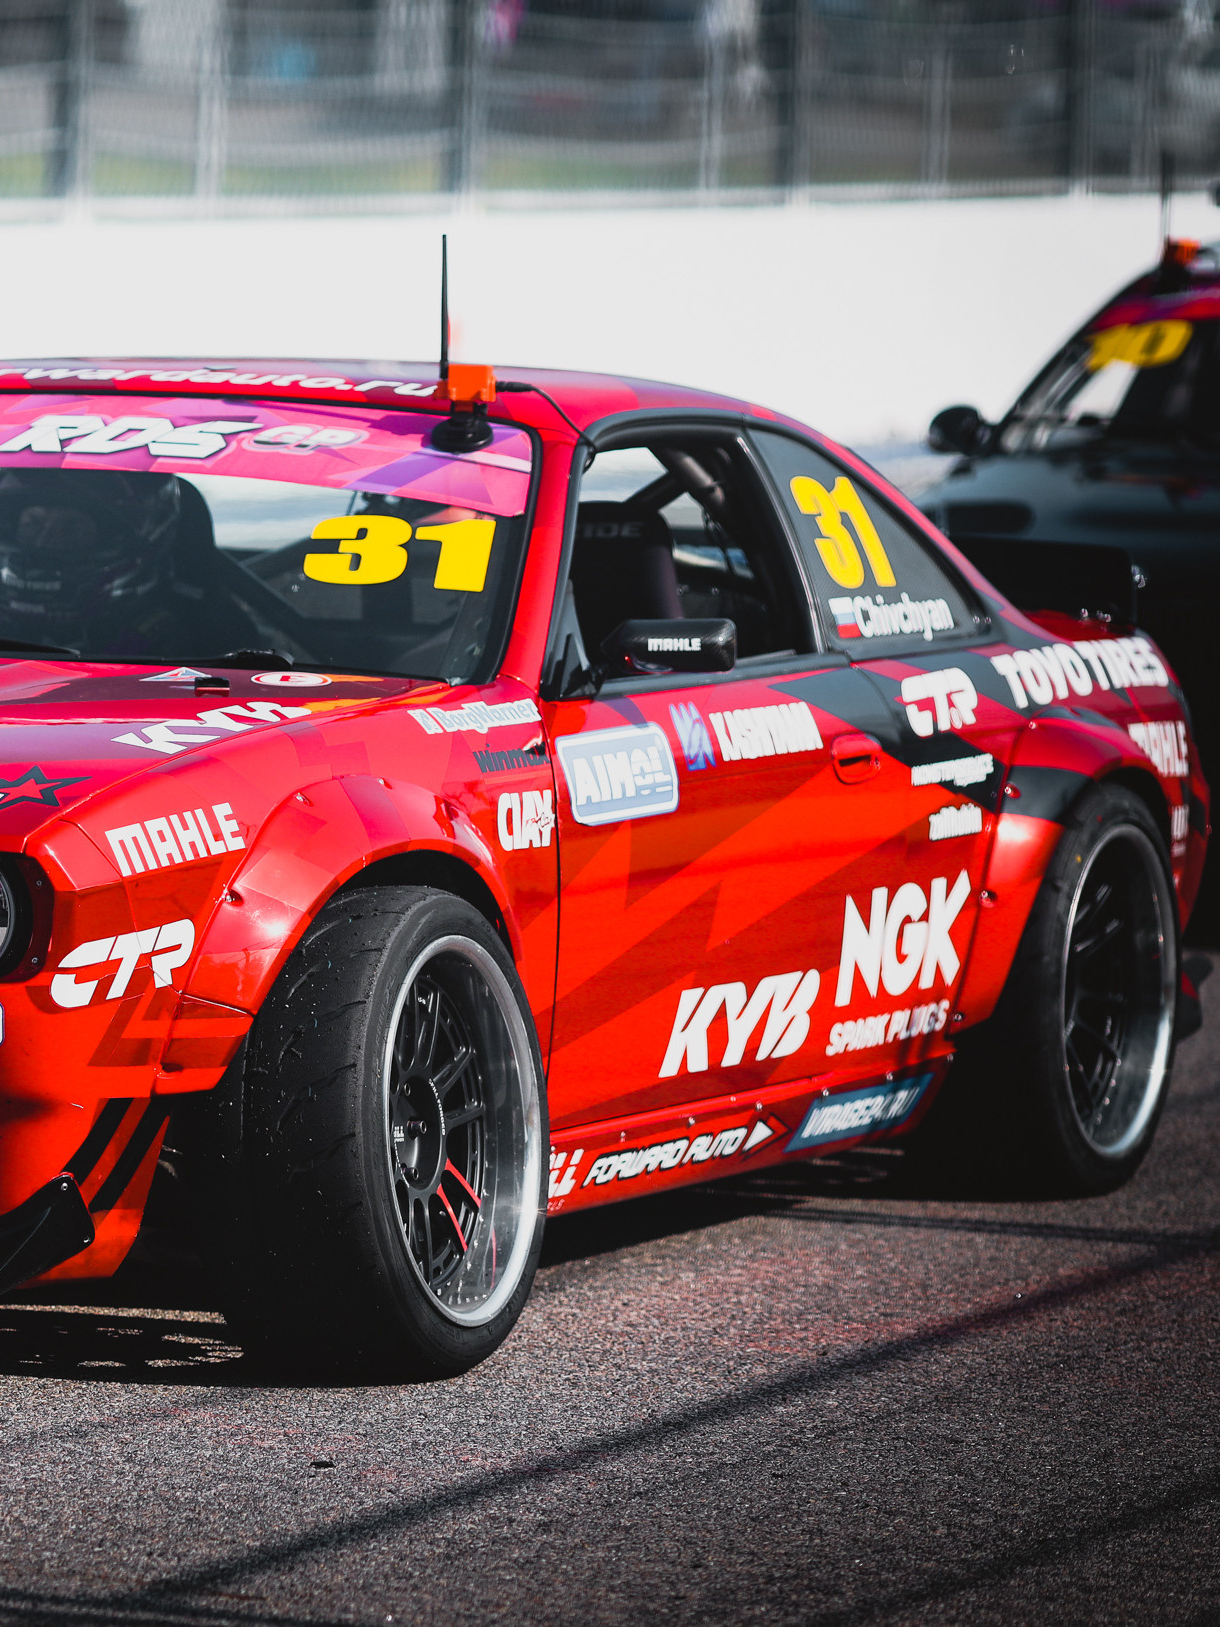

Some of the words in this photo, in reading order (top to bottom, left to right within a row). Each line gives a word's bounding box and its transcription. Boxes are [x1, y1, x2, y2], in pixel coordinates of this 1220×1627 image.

[303, 514, 498, 593] 31
[789, 475, 897, 589] 31
[647, 637, 702, 652] MAHLE
[990, 642, 1093, 709] TOYO
[1071, 636, 1170, 691] TIRES
[110, 701, 312, 754] KYB
[432, 700, 538, 731] BorgWarner
[104, 802, 246, 877] MAHLE
[835, 868, 972, 1007] NGK
[657, 968, 821, 1078] KYB
